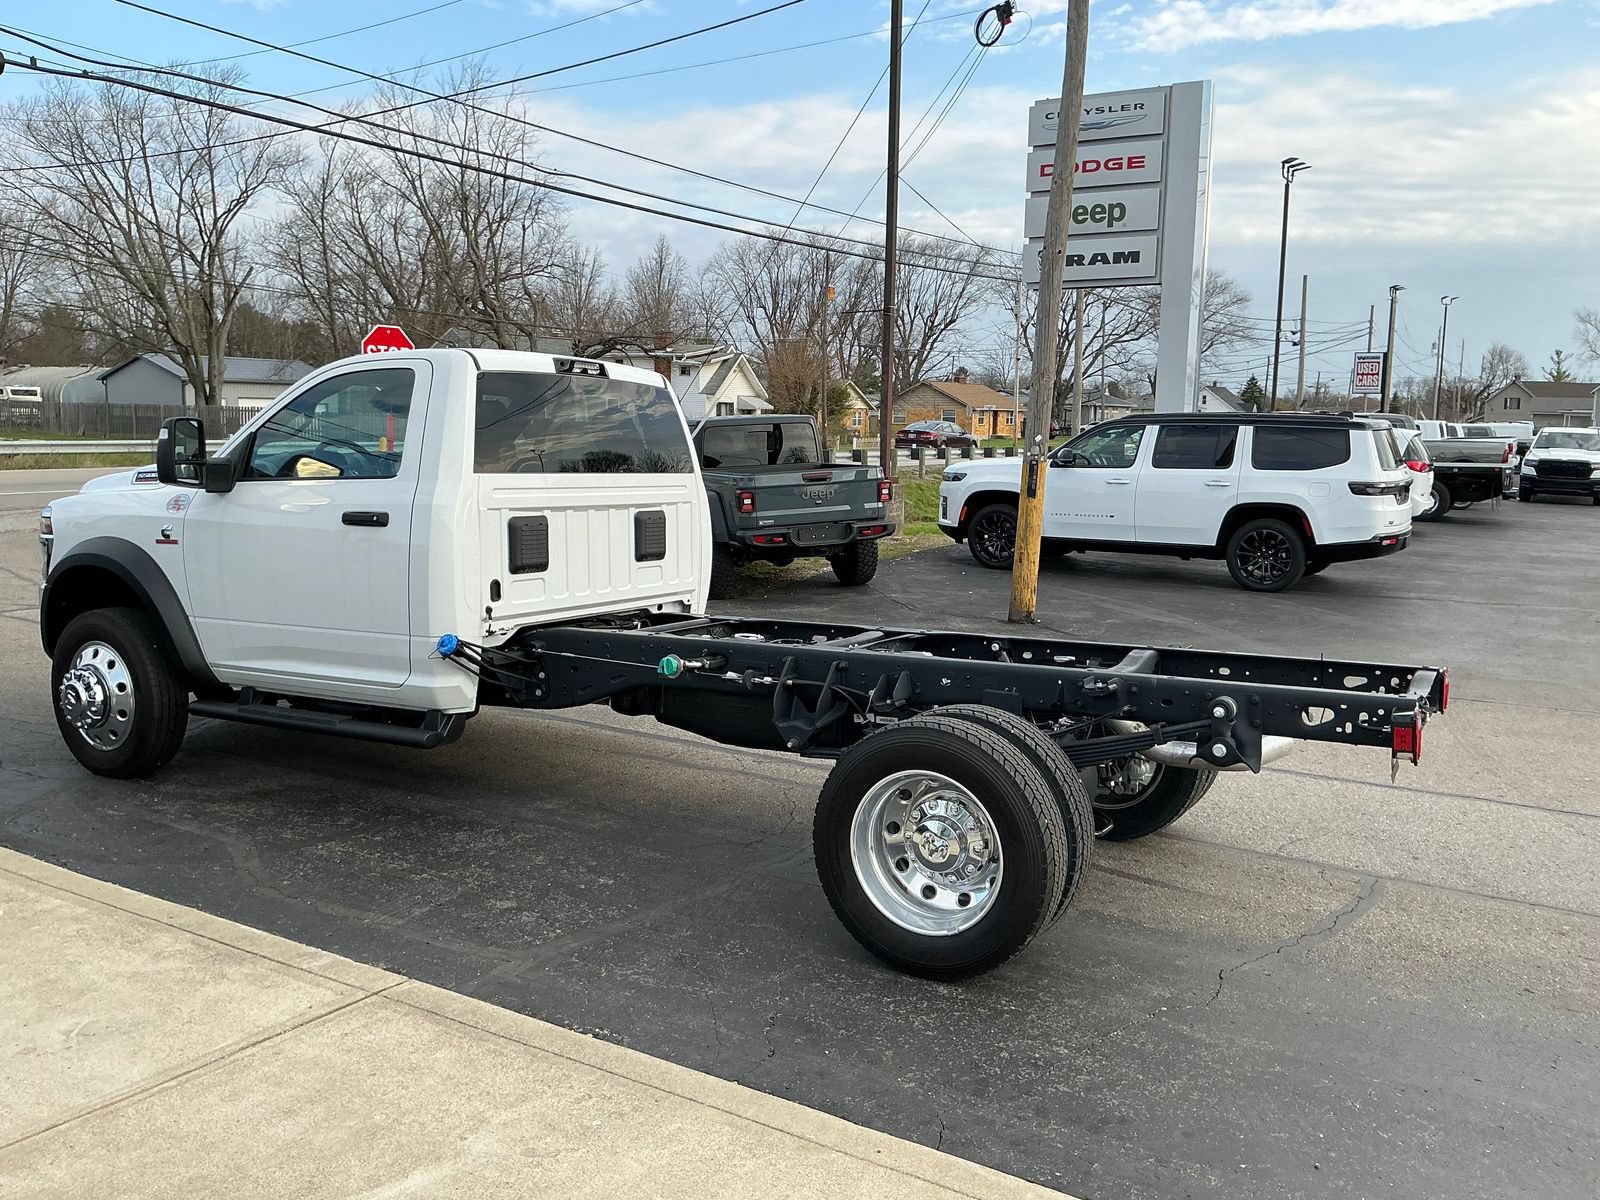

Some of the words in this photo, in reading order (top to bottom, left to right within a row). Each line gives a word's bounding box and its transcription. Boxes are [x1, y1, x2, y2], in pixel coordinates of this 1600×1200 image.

[1045, 103, 1145, 120] CYSLER
[1039, 155, 1146, 177] DDGE
[1070, 202, 1126, 228] eep
[1065, 250, 1140, 267] RAM
[1357, 362, 1379, 374] USED
[1356, 375, 1379, 386] CARS
[801, 486, 835, 500] Jeep
